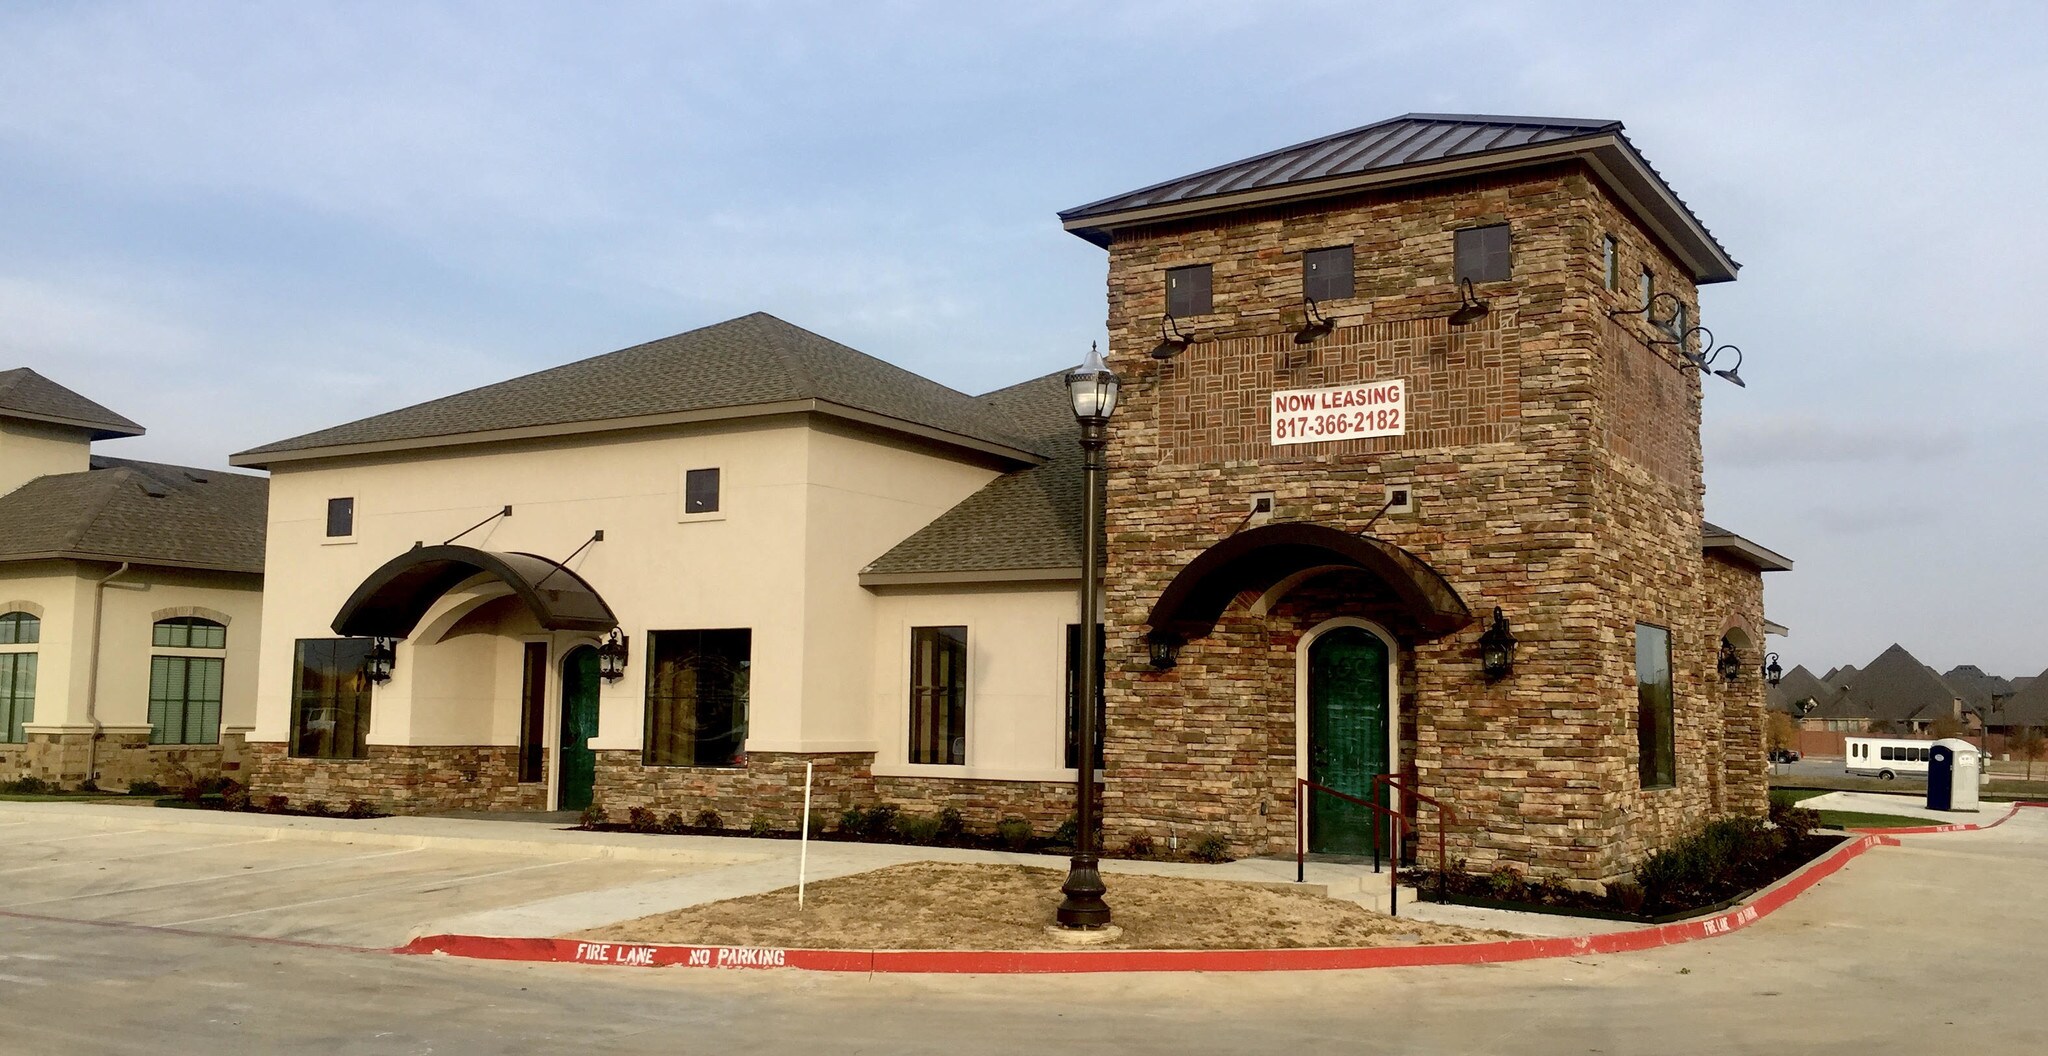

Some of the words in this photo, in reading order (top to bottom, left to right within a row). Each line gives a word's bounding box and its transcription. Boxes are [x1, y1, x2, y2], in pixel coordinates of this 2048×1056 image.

[1276, 394, 1315, 413] NOW
[1322, 386, 1400, 409] LEASING
[1276, 409, 1400, 438] 817-366-2182
[576, 943, 610, 961] FIRE
[617, 946, 657, 964] LANE
[689, 949, 710, 966] NO
[717, 948, 786, 966] PARKING
